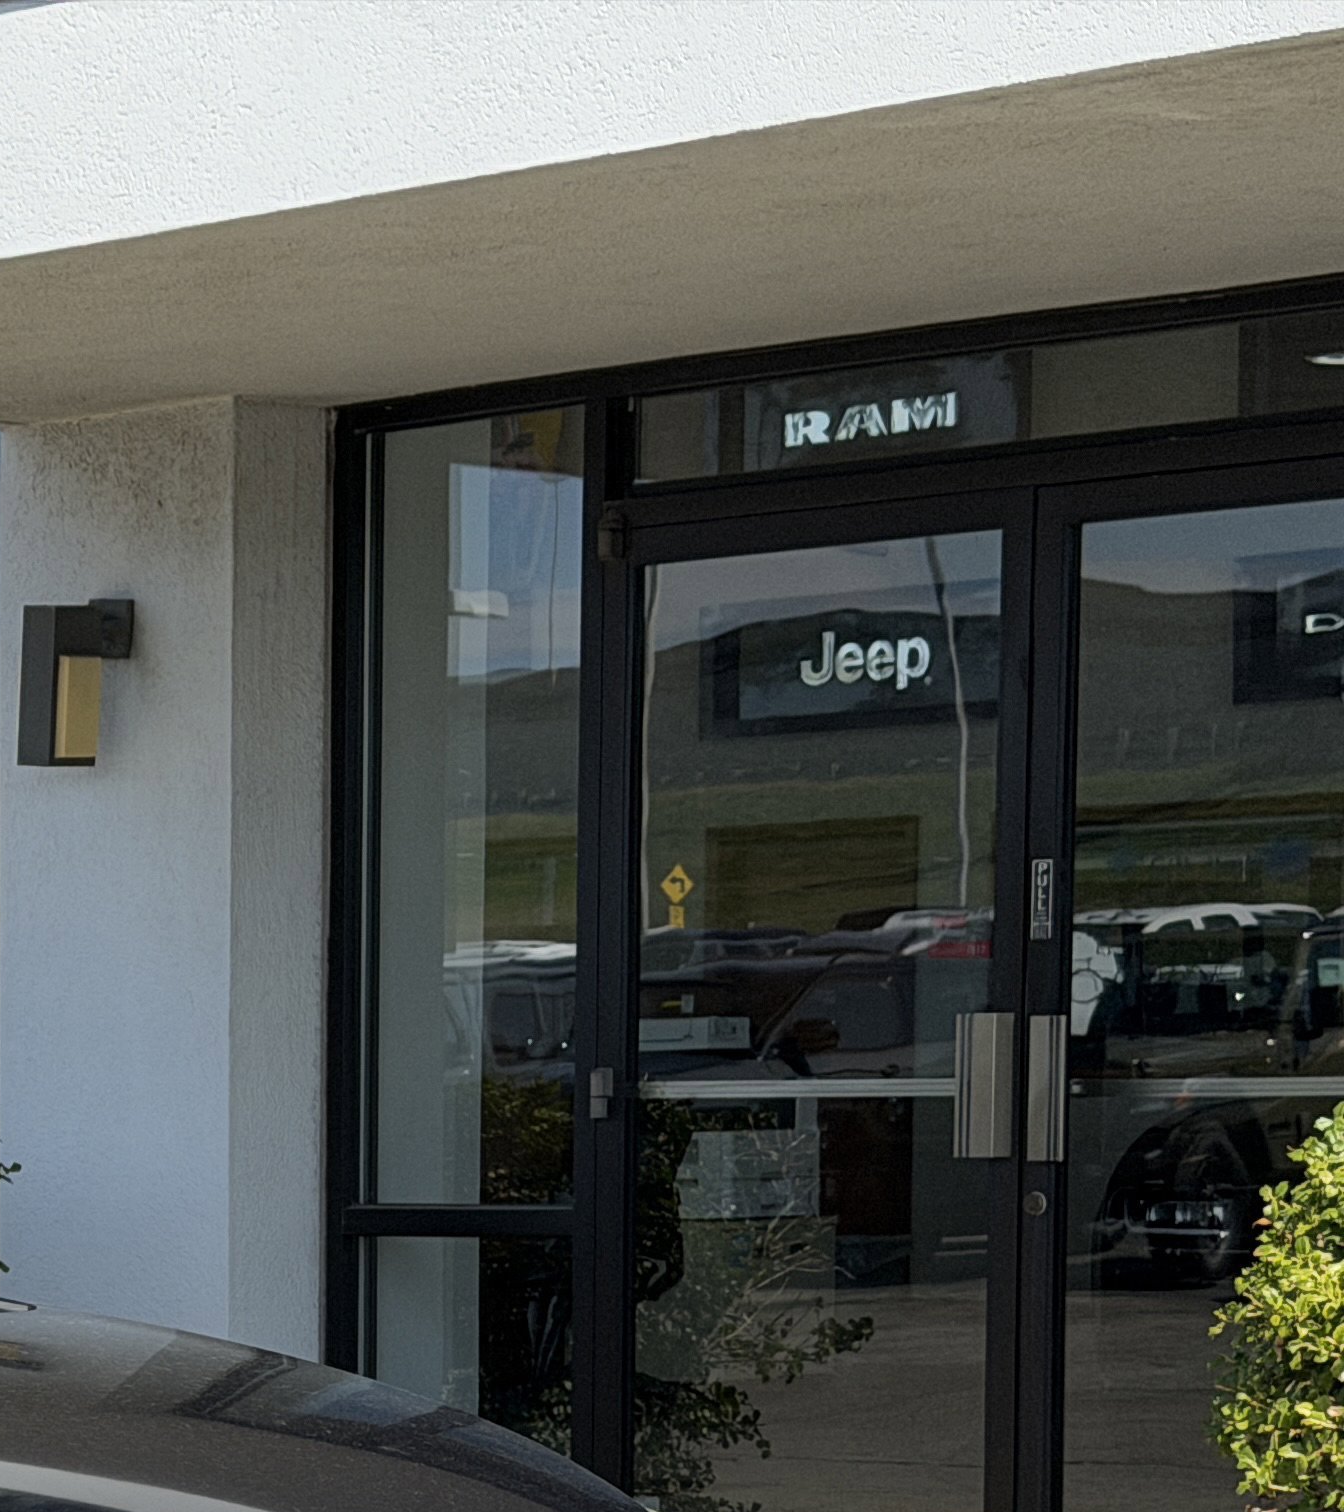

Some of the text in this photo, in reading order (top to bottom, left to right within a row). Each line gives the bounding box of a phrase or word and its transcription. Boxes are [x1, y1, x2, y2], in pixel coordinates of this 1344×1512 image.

[784, 391, 958, 447] RAM
[799, 631, 931, 690] Jeep
[1037, 861, 1048, 912] PULL
